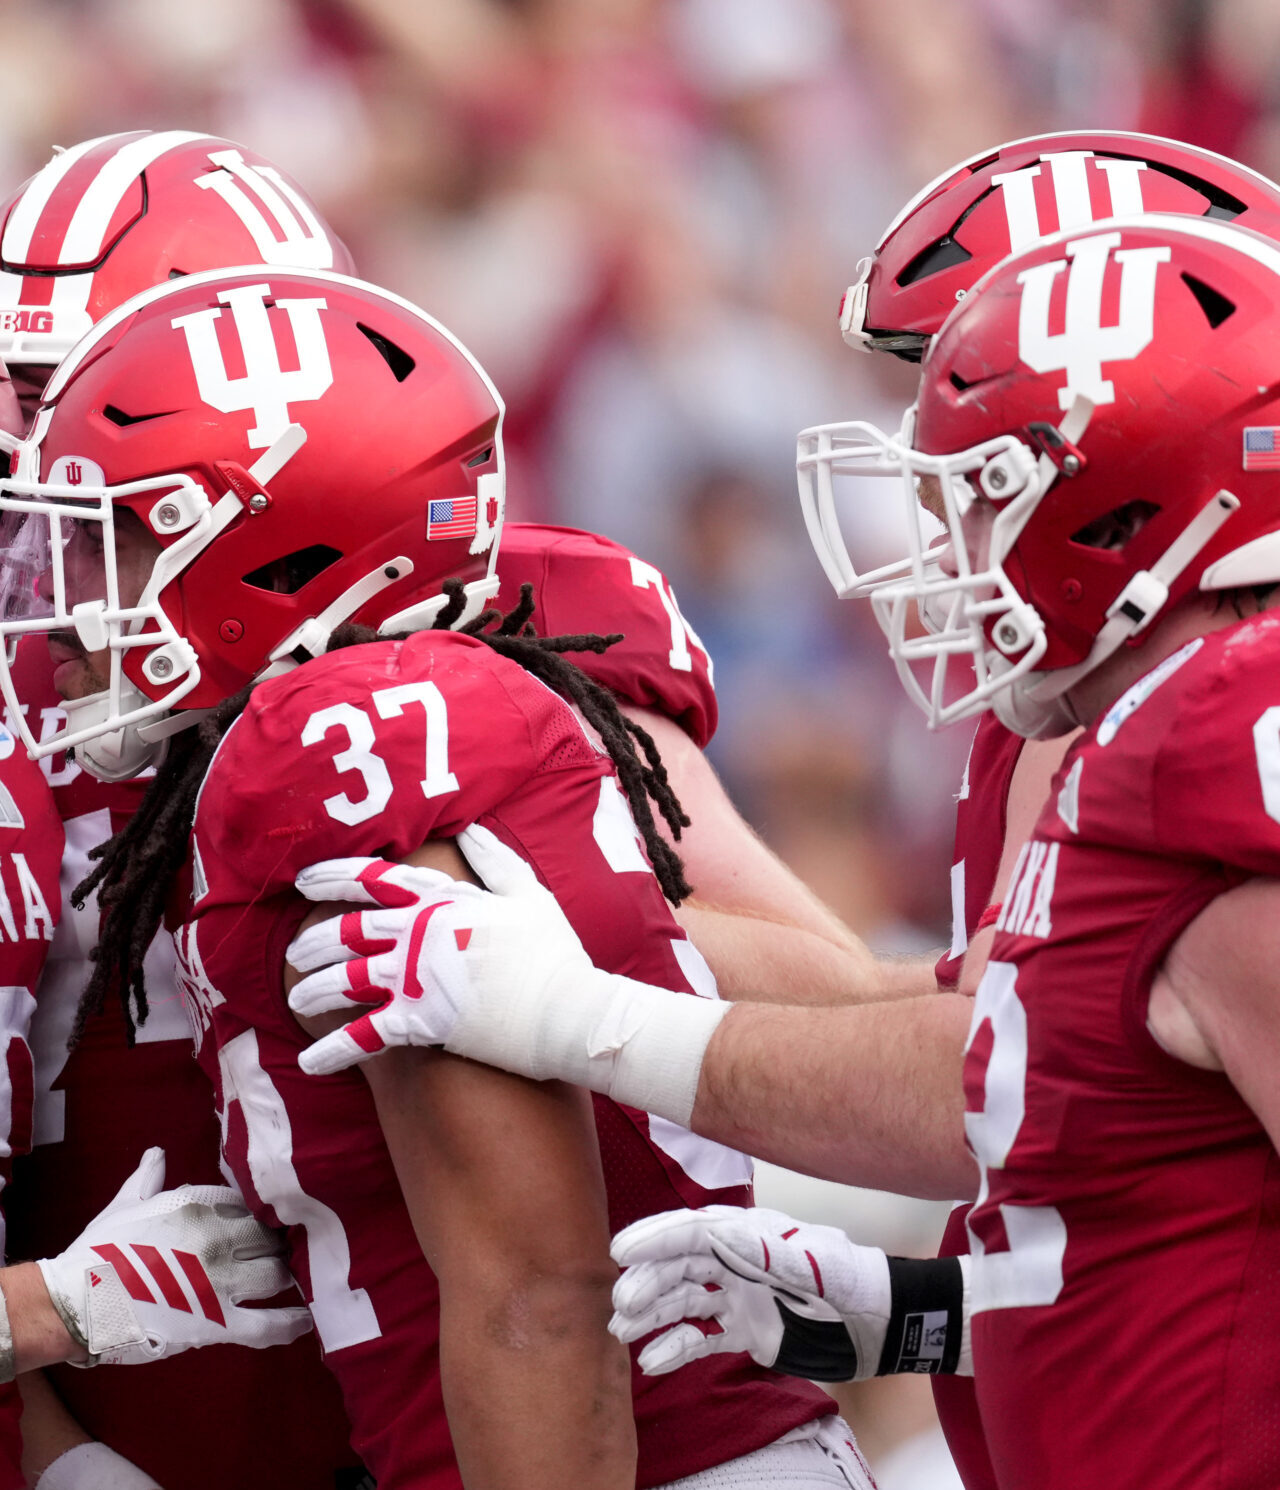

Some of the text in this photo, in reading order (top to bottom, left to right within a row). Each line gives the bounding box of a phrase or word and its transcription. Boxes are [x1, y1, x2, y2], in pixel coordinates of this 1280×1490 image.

[628, 556, 715, 690] 7
[300, 680, 461, 827] 37
[996, 840, 1061, 939] NA
